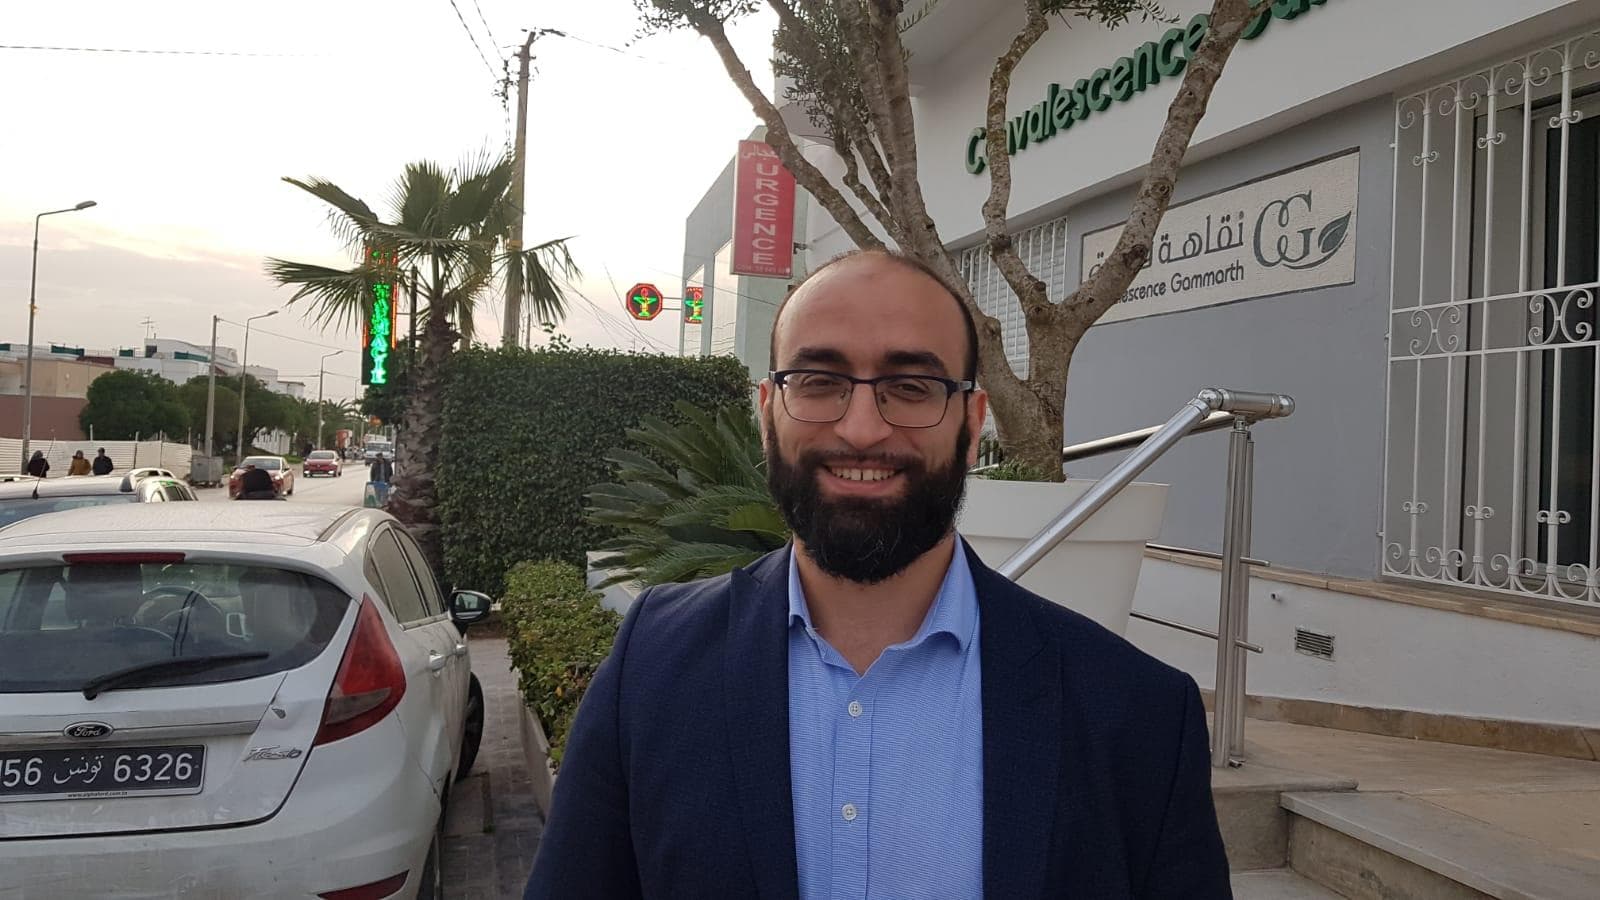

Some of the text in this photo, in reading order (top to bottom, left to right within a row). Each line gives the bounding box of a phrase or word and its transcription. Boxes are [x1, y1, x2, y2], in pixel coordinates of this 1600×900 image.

[965, 13, 1210, 175] Cvalescence
[752, 163, 780, 266] URGENCE
[1158, 210, 1245, 264] نقاهة
[1121, 281, 1167, 303] escence
[1170, 259, 1245, 293] Gammarth
[73, 725, 103, 738] Ford
[53, 755, 104, 784] تونس
[113, 752, 193, 783] 6326
